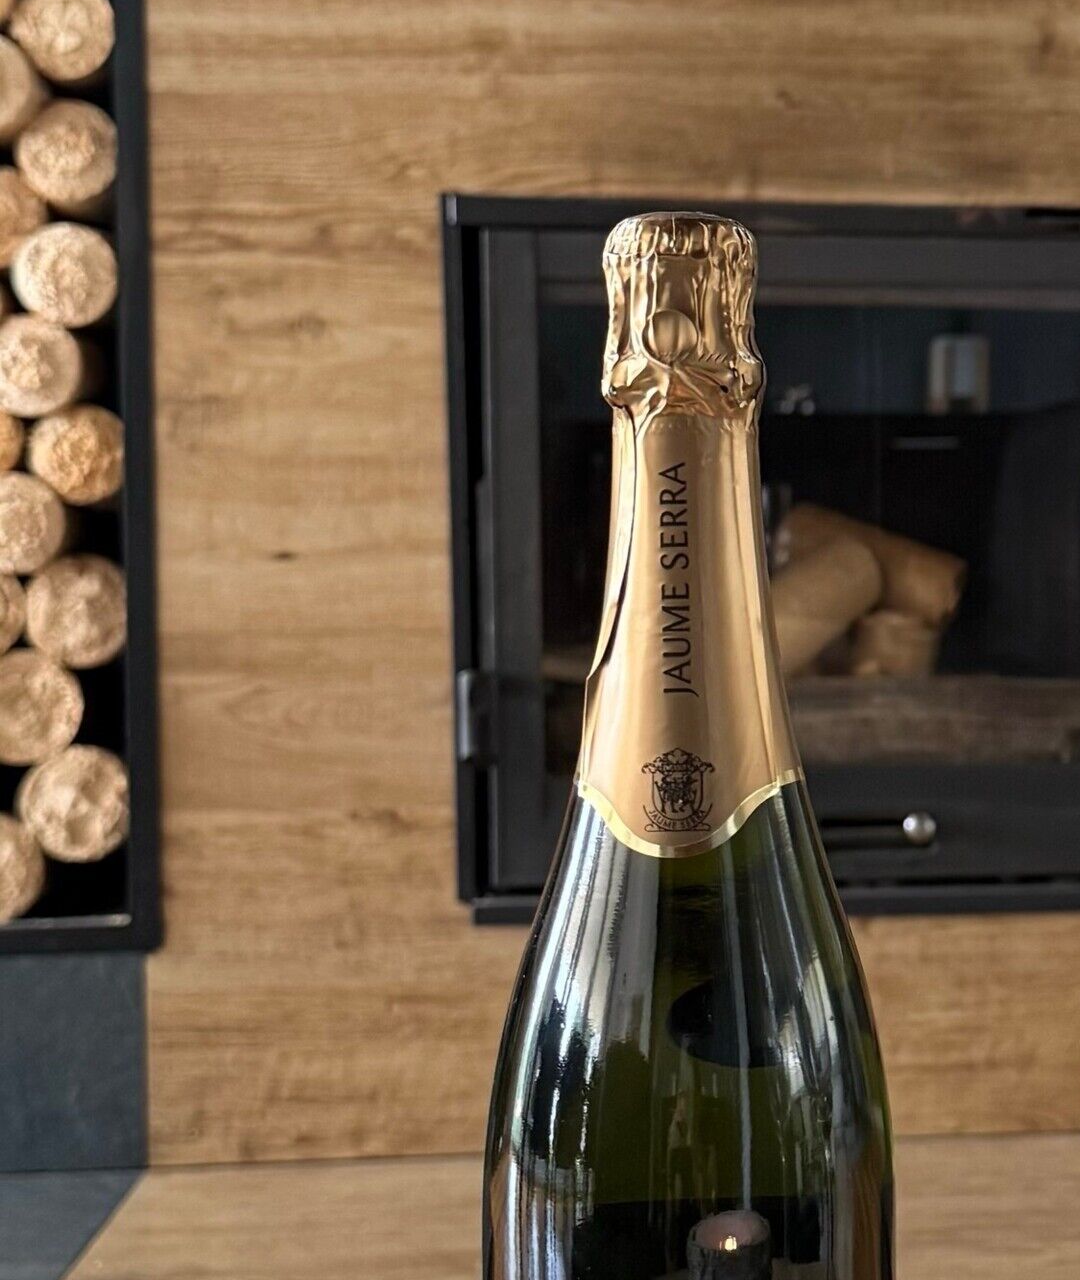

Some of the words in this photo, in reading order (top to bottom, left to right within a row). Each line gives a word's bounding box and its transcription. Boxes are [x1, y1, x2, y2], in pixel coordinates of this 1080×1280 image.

[658, 462, 690, 570] SERRA
[661, 582, 699, 698] JAUME
[648, 809, 676, 830] JAUME
